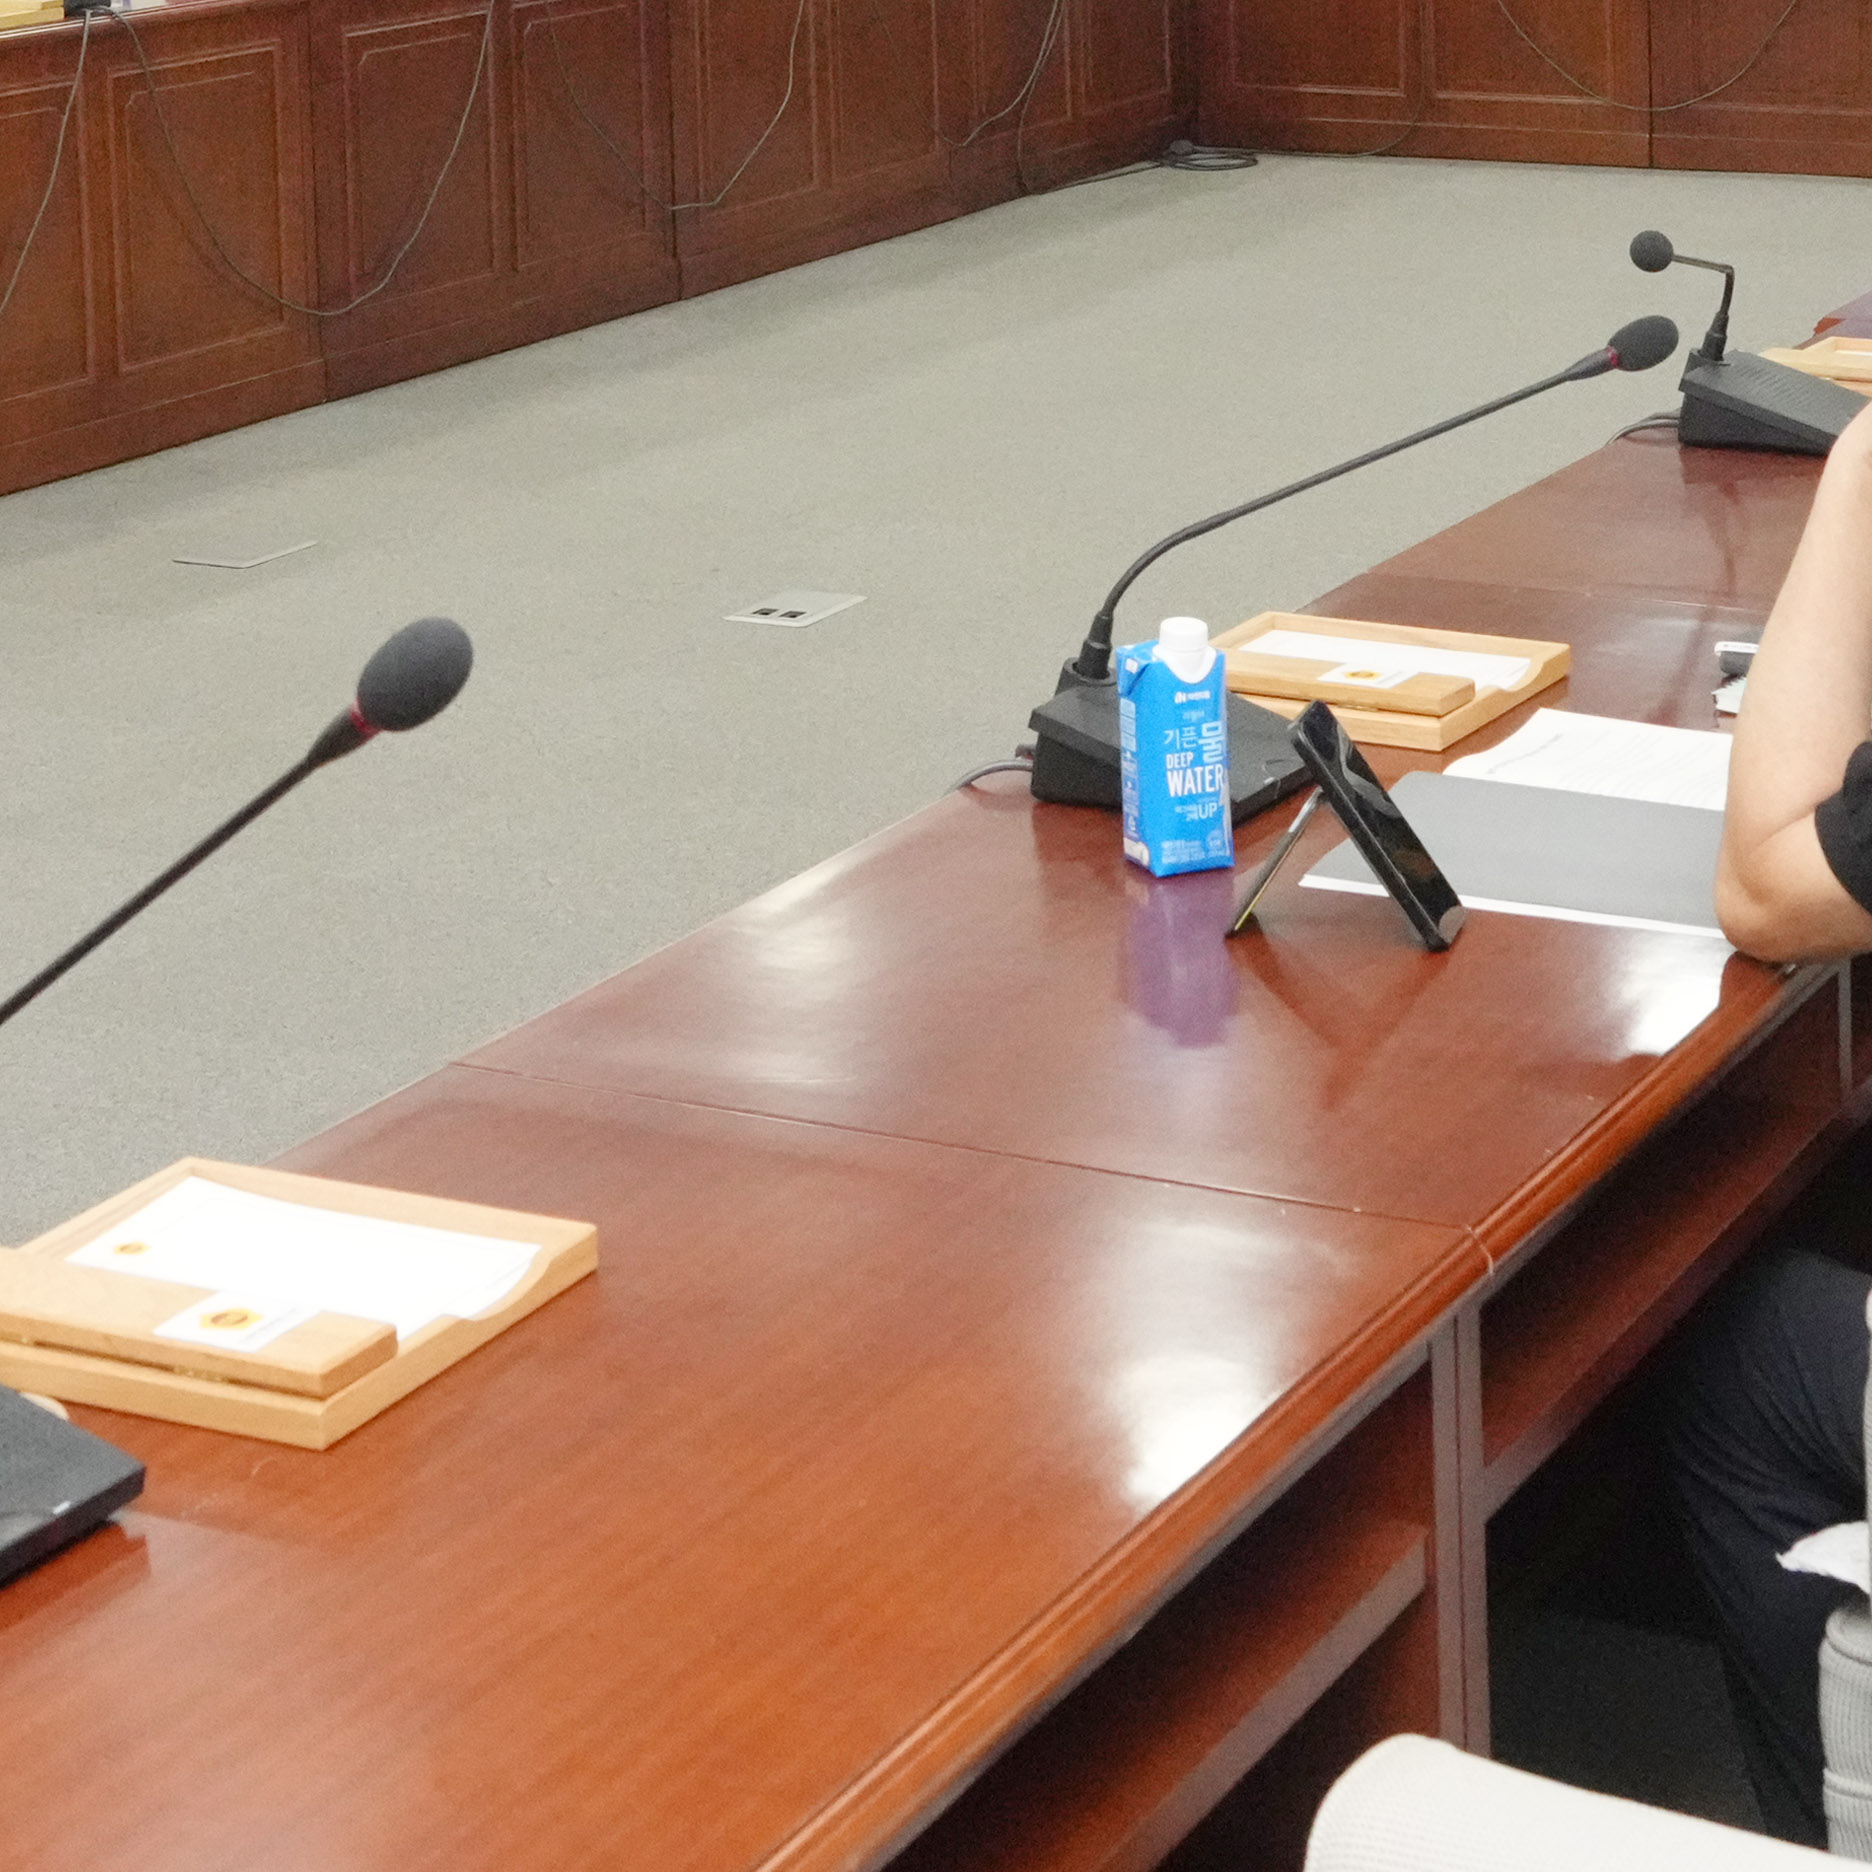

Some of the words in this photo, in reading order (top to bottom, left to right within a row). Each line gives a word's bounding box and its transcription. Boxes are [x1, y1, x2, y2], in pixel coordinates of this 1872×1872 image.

[1166, 752, 1195, 770] DEEP
[1167, 763, 1225, 797] WATER
[1198, 802, 1219, 820] UP
